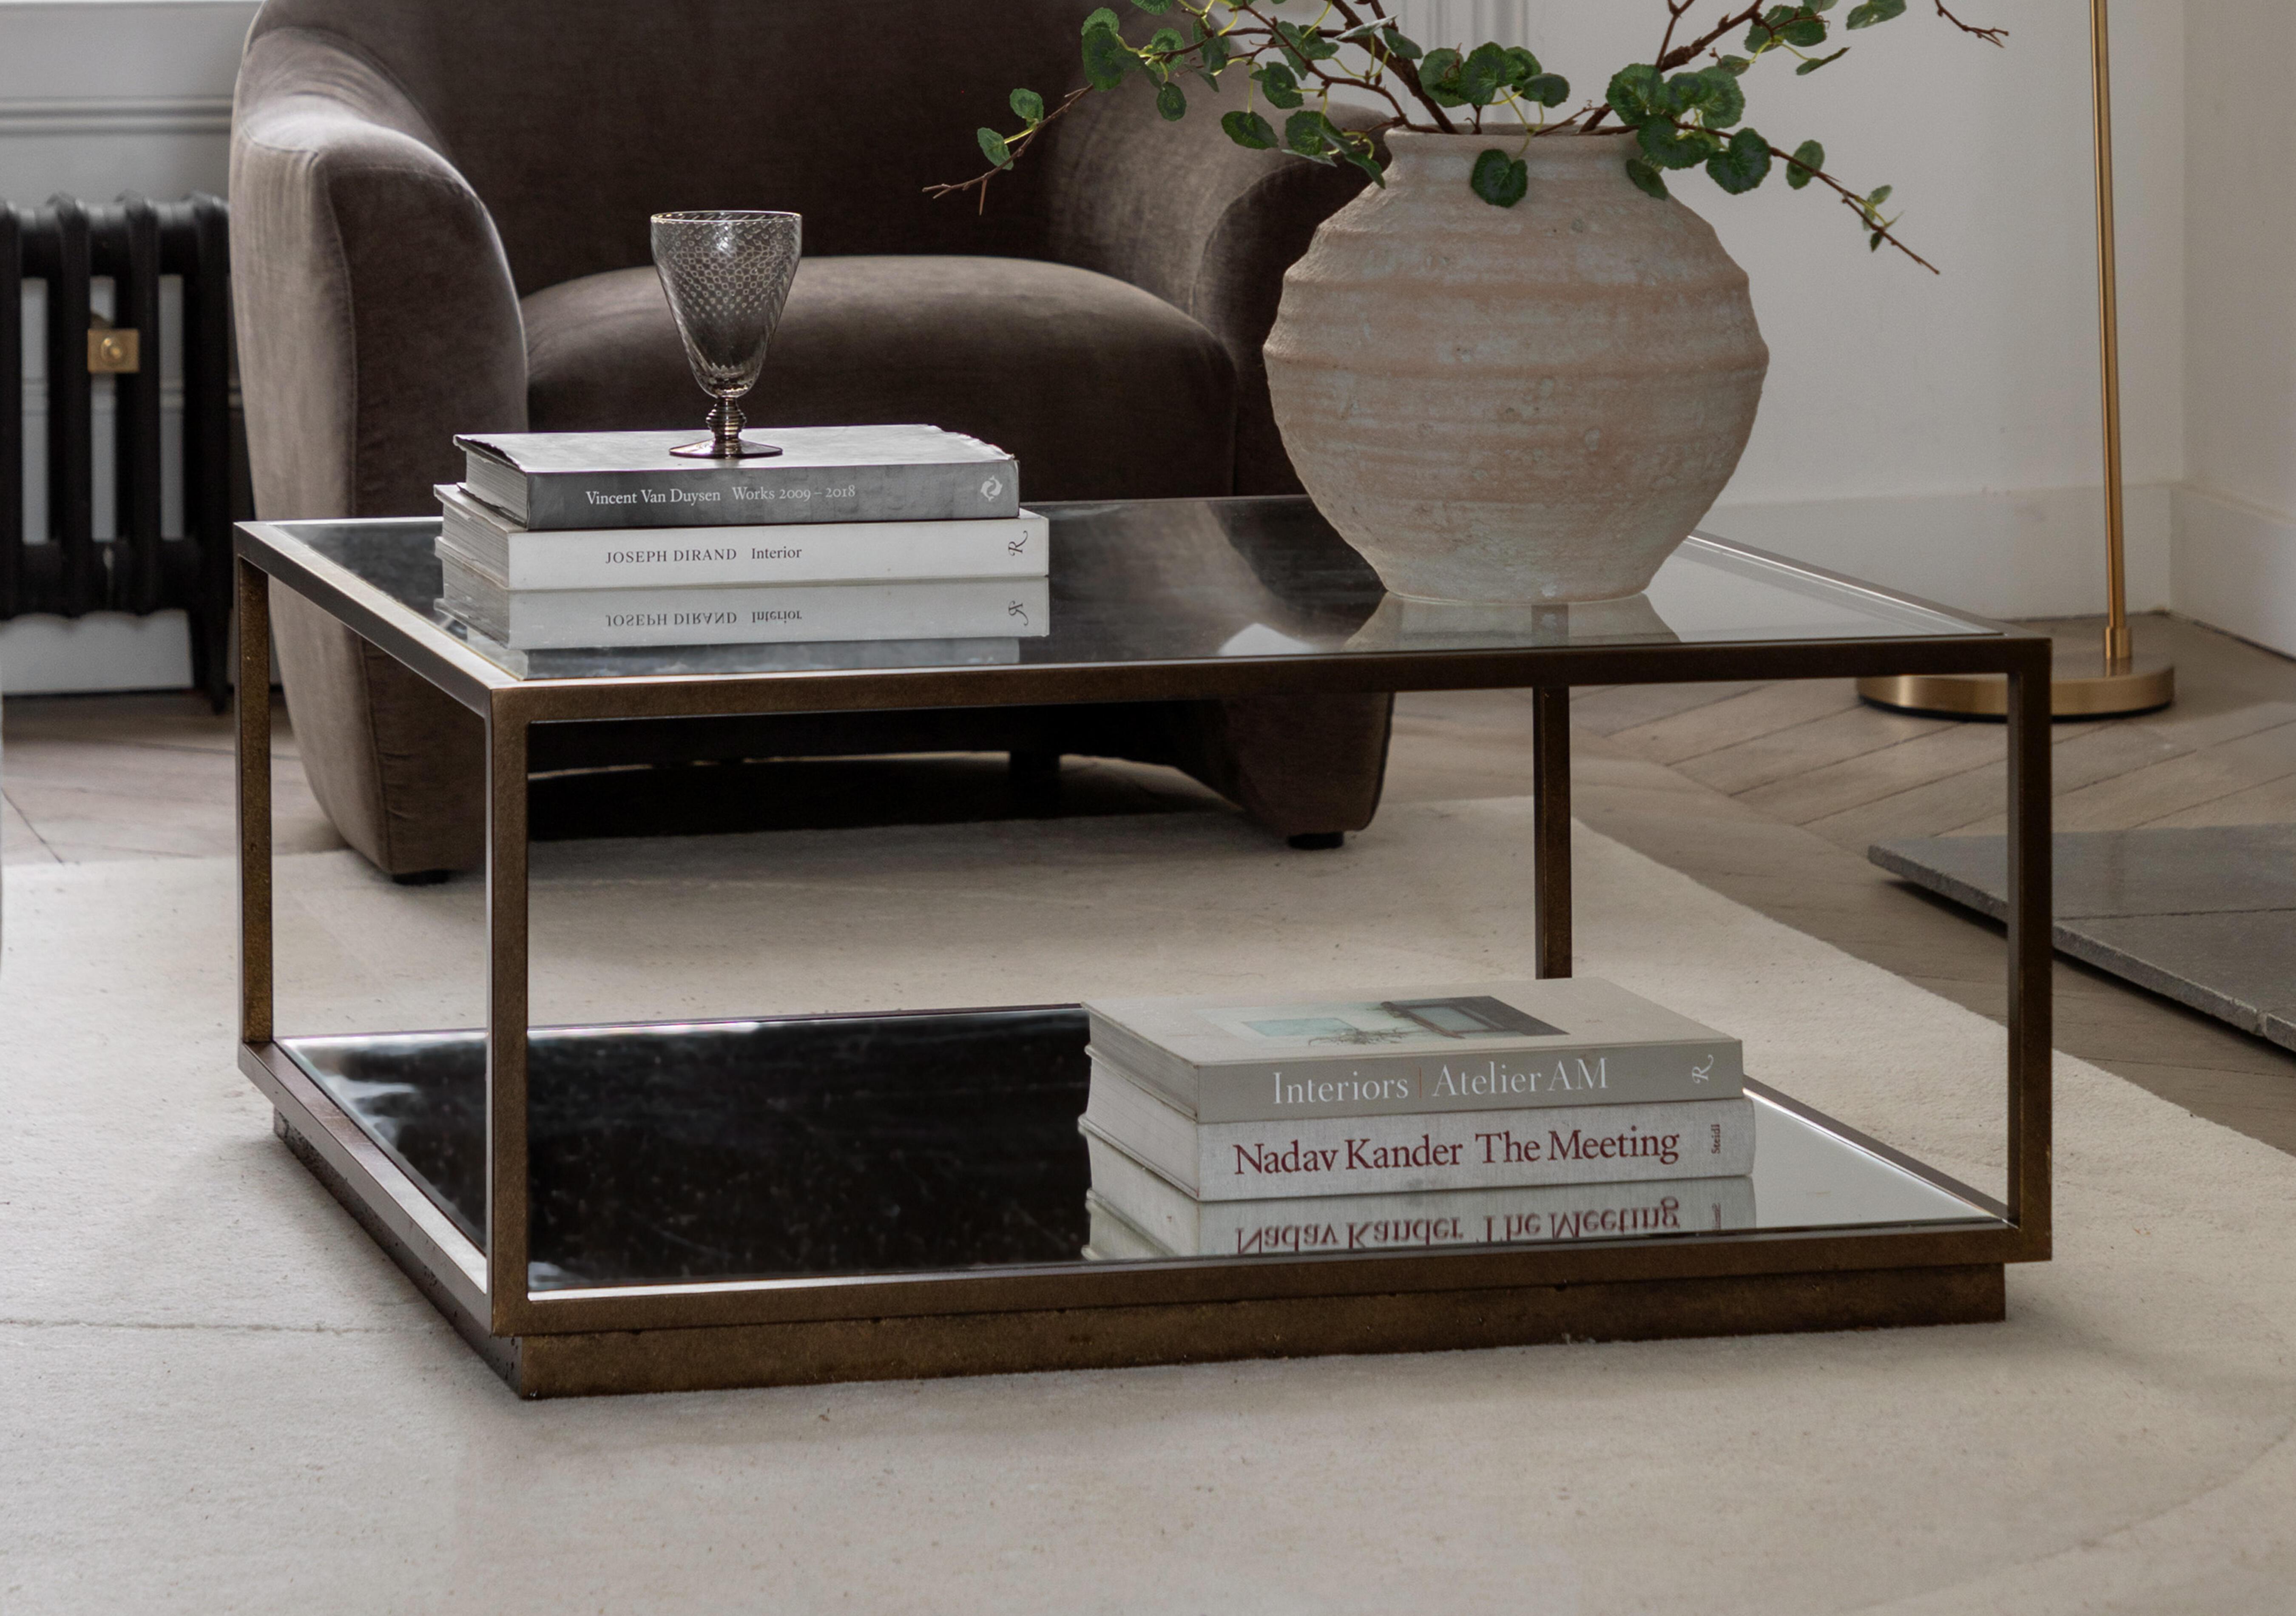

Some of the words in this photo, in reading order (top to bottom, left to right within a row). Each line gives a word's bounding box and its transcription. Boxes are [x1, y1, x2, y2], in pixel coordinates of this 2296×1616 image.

[585, 490, 637, 505] Vincent
[641, 489, 666, 503] Van
[670, 488, 721, 506] Duysen
[732, 486, 775, 501] Works
[605, 550, 667, 564] JOSEPH
[673, 548, 737, 562] DIRAND
[751, 546, 802, 559] Interior
[1273, 1070, 1409, 1105] Interiors
[1432, 1061, 1542, 1097] Atelier
[1547, 1057, 1609, 1092] AM
[1233, 1139, 1338, 1175] Nadav
[1344, 1133, 1463, 1171] Kander
[1475, 1130, 1541, 1164] The
[1547, 1125, 1680, 1165] Meeting
[1711, 1124, 1721, 1154] Steidl
